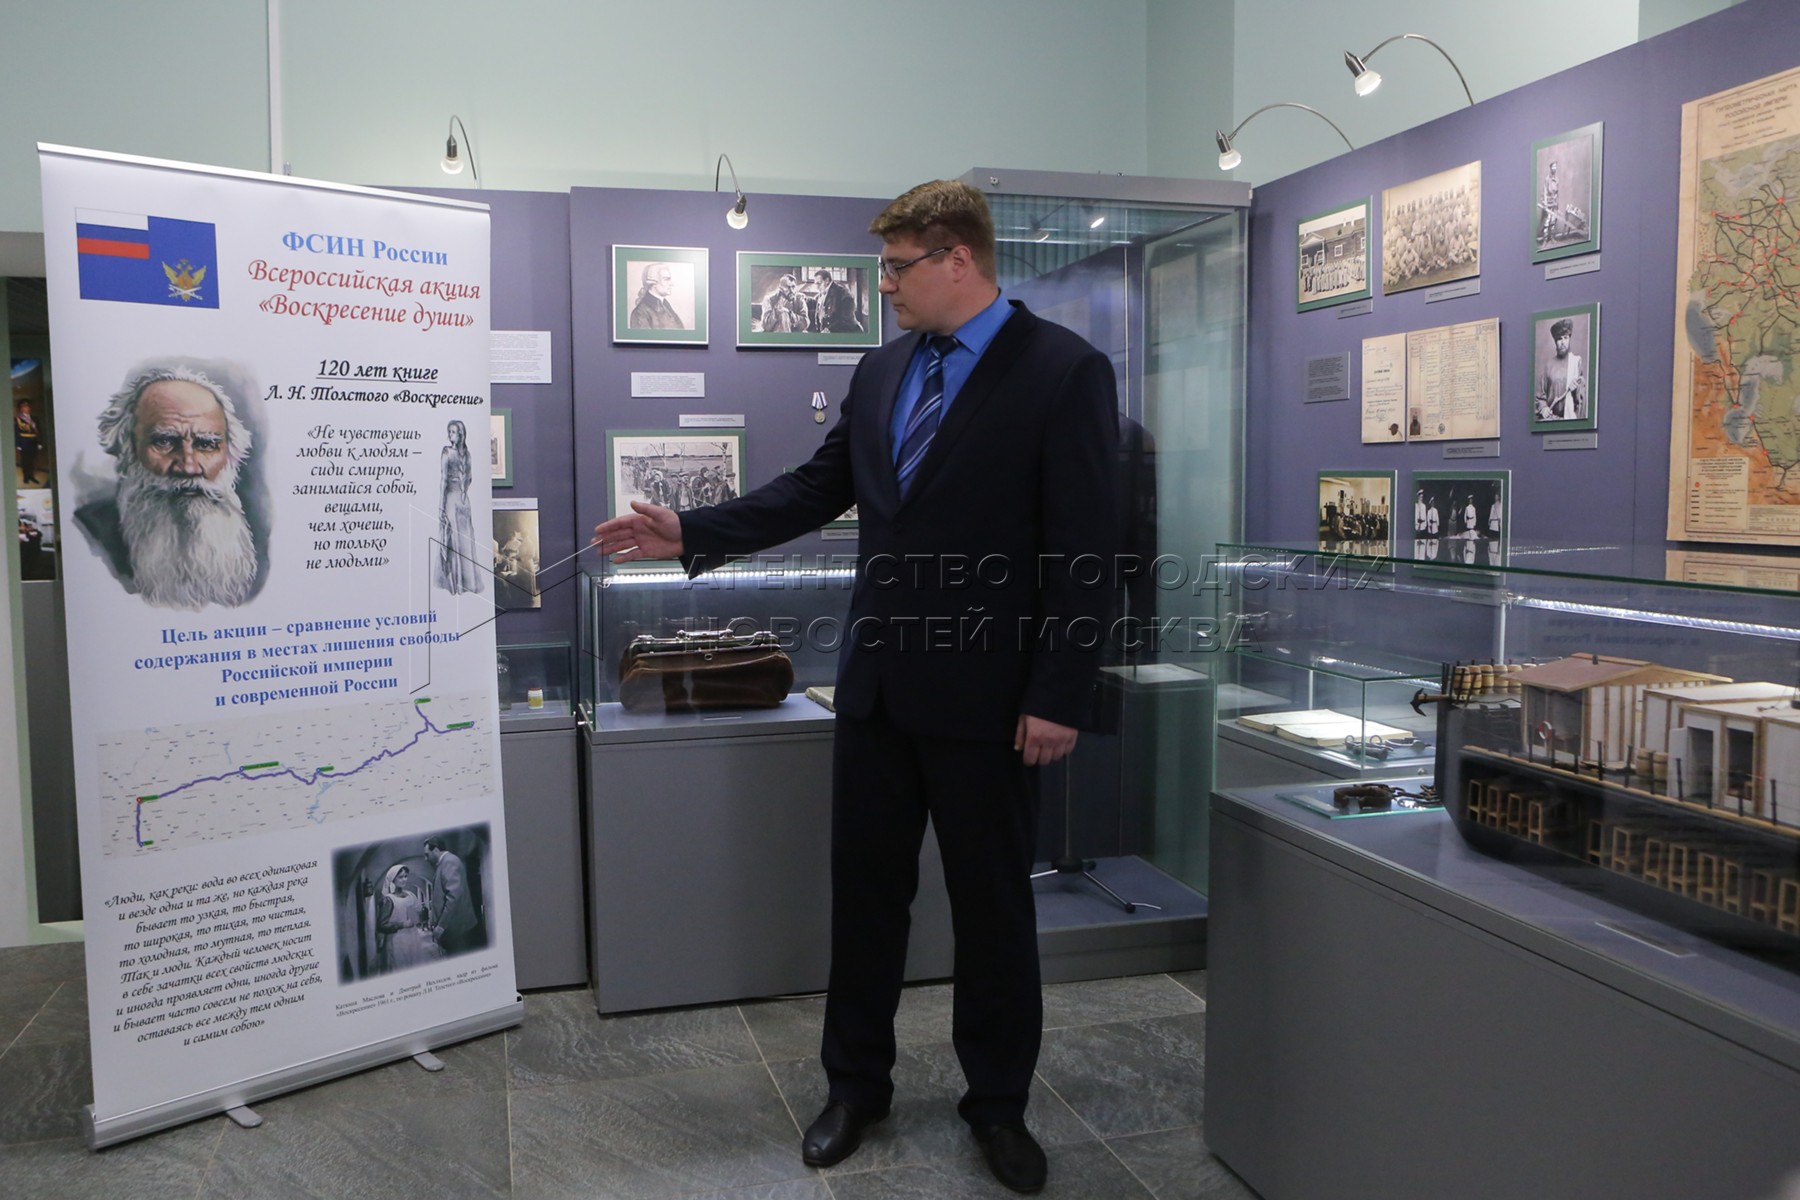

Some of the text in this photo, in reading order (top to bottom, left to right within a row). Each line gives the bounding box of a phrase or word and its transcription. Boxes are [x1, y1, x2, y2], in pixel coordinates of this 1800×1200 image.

[282, 231, 448, 266] ФСИН России
[248, 259, 481, 302] Всероссийская акция
[259, 294, 474, 332] «Воскресение души»
[317, 359, 439, 383] 120 лет книге
[264, 385, 484, 408] Л. Н. Толстого «Воскресение»
[296, 441, 342, 458] любви
[347, 447, 359, 461] к
[359, 442, 408, 458] людям
[307, 424, 421, 445] «Не чувствуешь
[292, 478, 417, 496] занимайся собой,
[310, 460, 405, 480] сиди смирно,
[308, 518, 394, 534] чем хочешь,
[324, 500, 384, 516] вещами,
[306, 552, 390, 570] не людьми»
[314, 537, 387, 551] но только
[161, 626, 208, 646] Цель
[213, 623, 267, 641] акции
[286, 615, 371, 638] сравнение
[375, 609, 438, 630] условий
[134, 630, 460, 672] содержания в местах лишения свободы
[221, 655, 394, 685] Российской империи
[215, 675, 398, 706] и современной России
[104, 860, 318, 908] «Люди, как реки: вода во всех одинаковая
[118, 876, 308, 921] и везде одна и та же, но каждая река
[123, 906, 306, 952] то широкая, то тихая, то чистая,
[135, 894, 295, 933] бывает то узкая, то быстрая,
[119, 920, 311, 968] то холодная, то мутная, то теплая.
[120, 934, 312, 984] Так и люди. Каждый человек носит
[116, 961, 320, 1016] и иногда проявляет одни, иногда другие
[122, 948, 314, 999] в себе зачатки всех свойств людских
[113, 973, 323, 1032] и бывает часто совсем не похож на себя,
[137, 994, 305, 1042] оставаясь все между тем одним
[183, 1018, 265, 1046] и самим собою»
